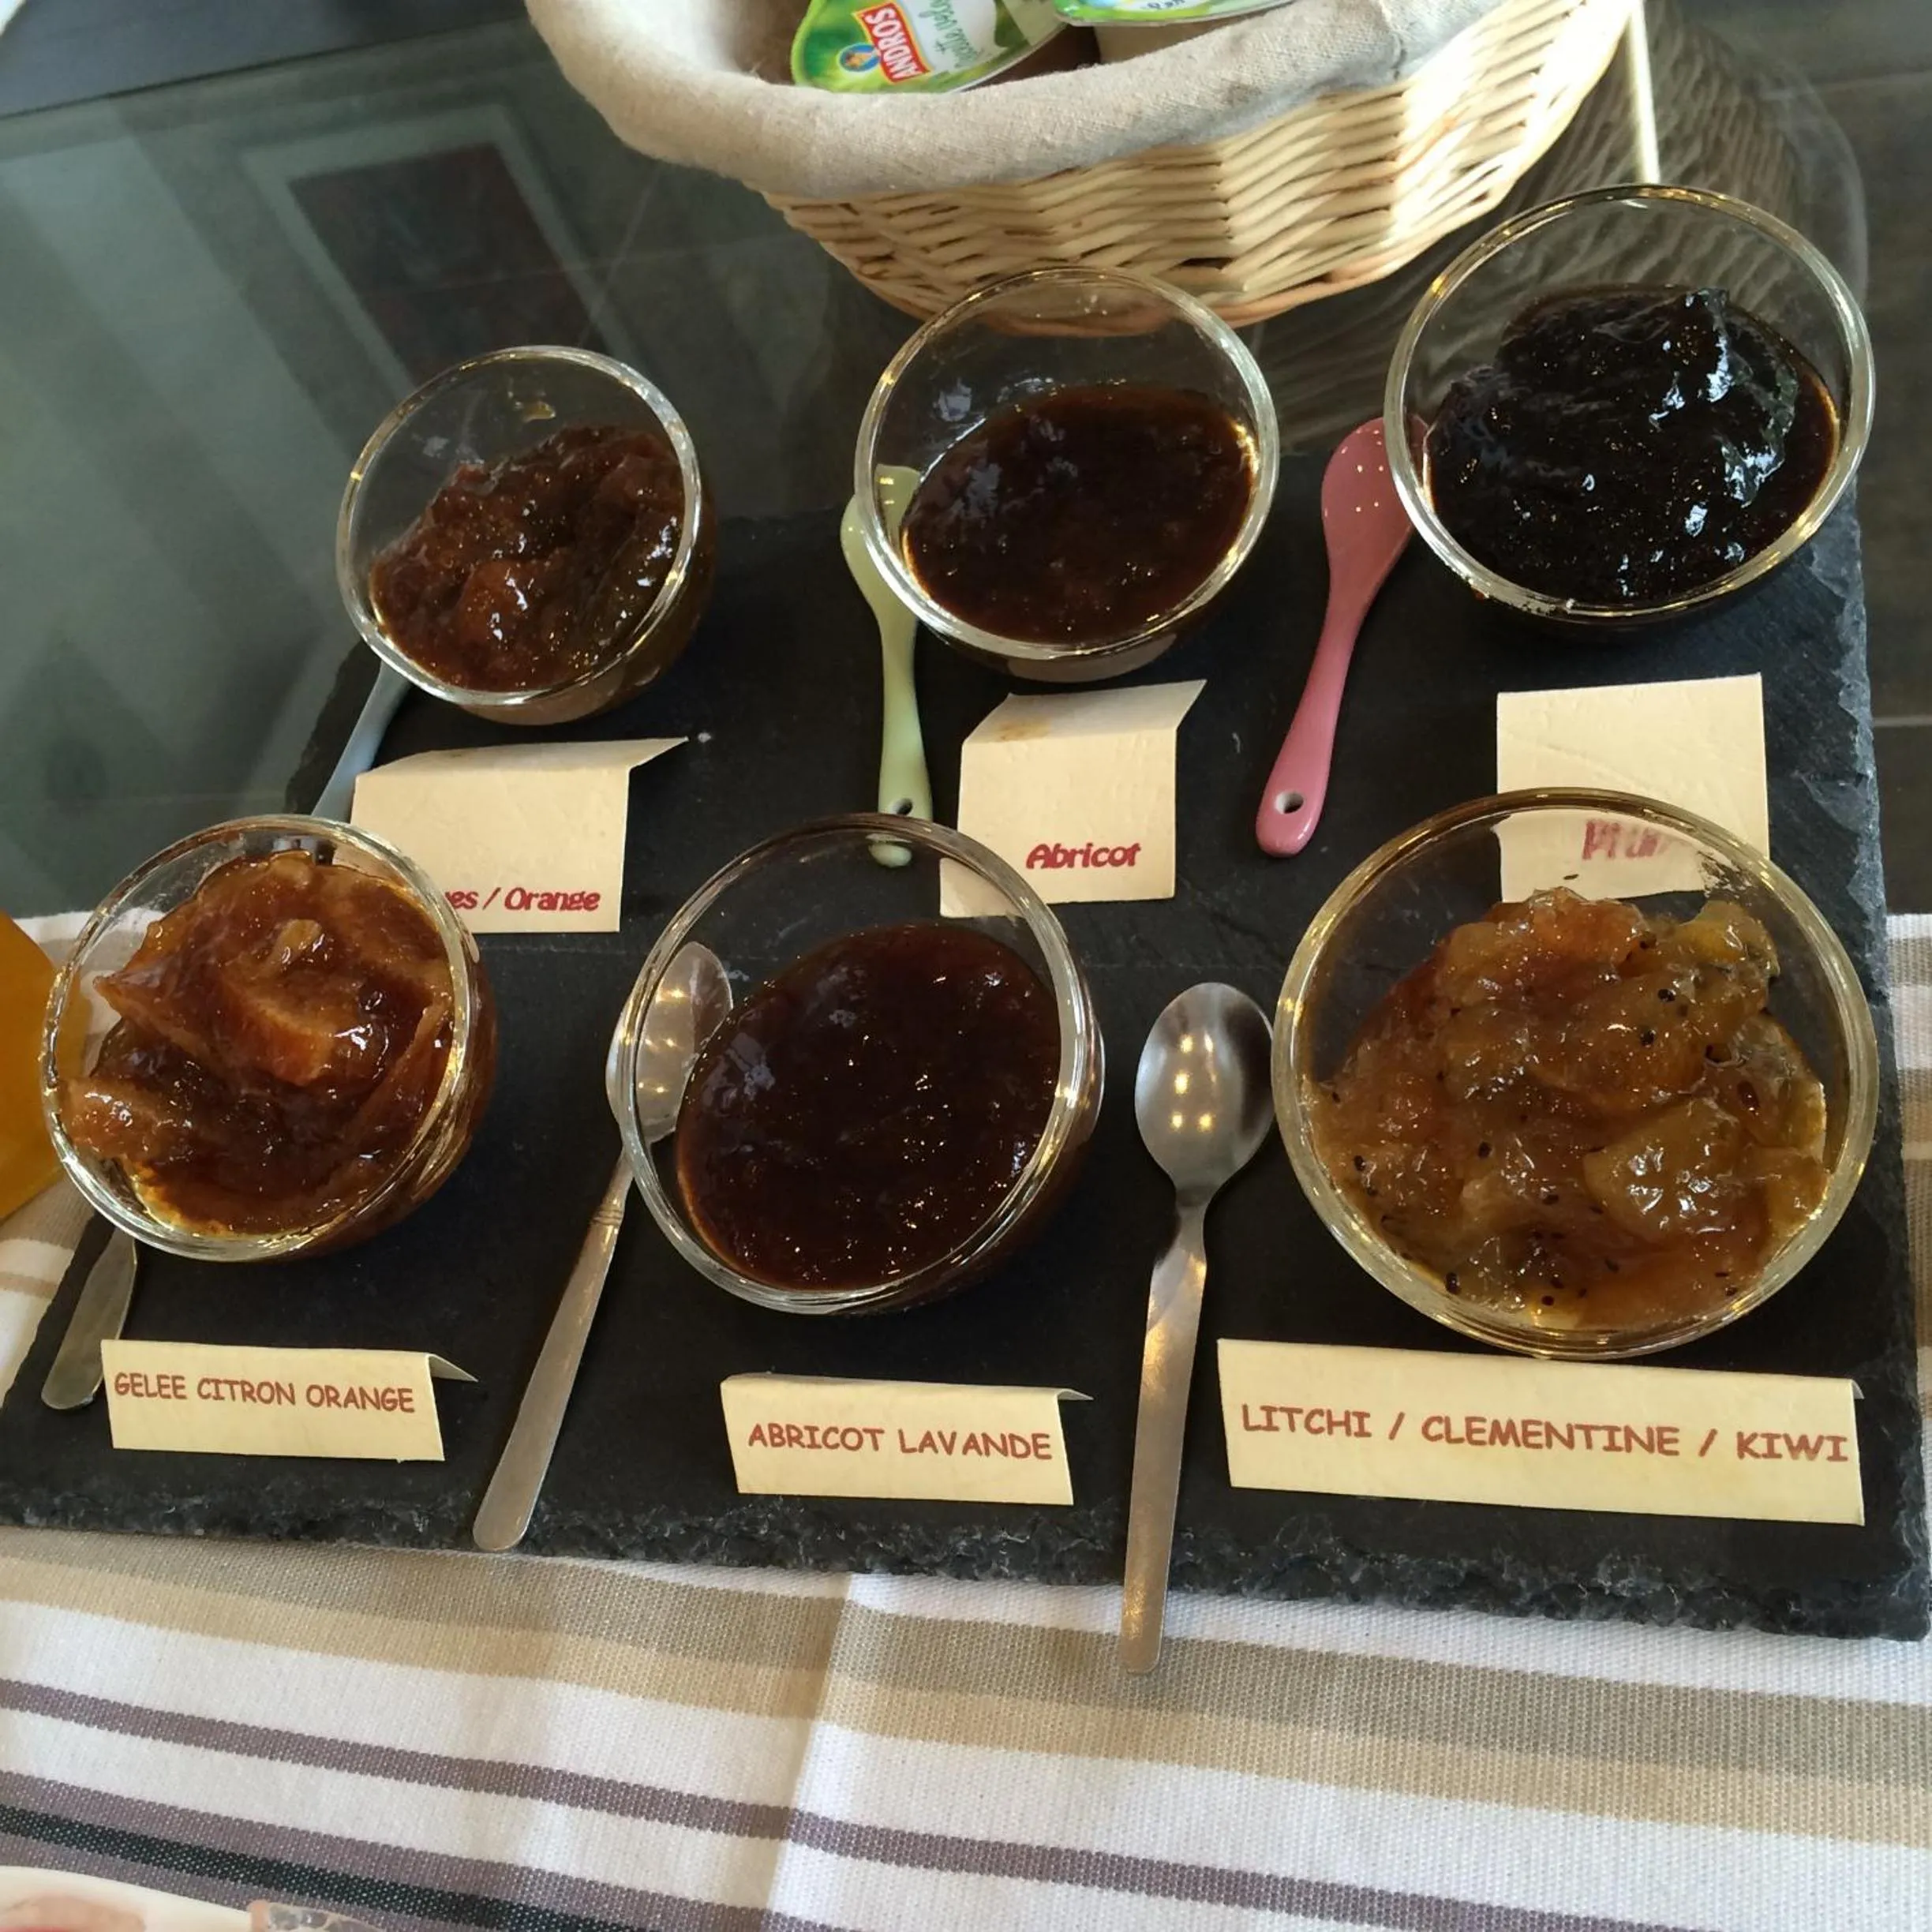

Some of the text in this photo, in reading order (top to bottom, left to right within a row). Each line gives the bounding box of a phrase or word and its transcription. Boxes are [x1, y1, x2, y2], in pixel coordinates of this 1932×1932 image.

[864, 7, 922, 80] ANDROS
[1025, 842, 1141, 870] Abricot
[481, 887, 502, 910] /
[504, 886, 601, 912] Orange
[114, 1372, 415, 1413] GELEE CITRON ORANGE
[747, 1423, 1052, 1460] ABRICOT LAVANDE
[1241, 1404, 1849, 1462] LITCHI / CLEMENTINE / KIWI
